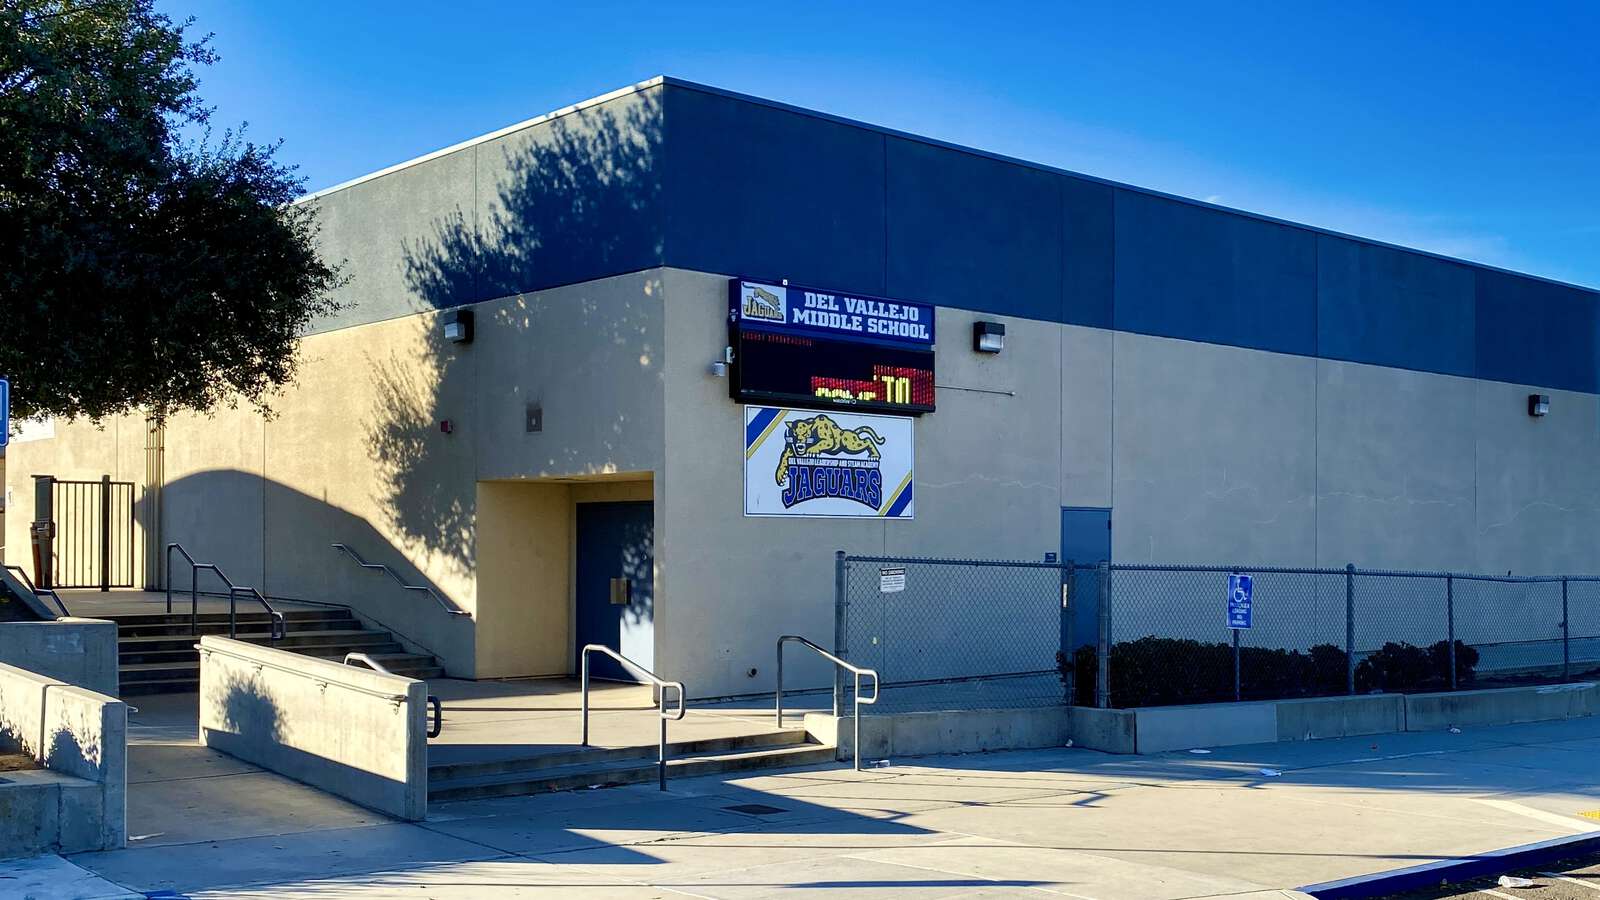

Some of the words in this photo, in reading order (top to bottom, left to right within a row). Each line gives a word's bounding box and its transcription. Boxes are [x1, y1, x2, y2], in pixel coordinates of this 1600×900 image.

[804, 292, 839, 311] DEL
[844, 297, 919, 322] VALLEJO
[792, 308, 862, 332] MIDDLE
[867, 318, 929, 340] SCHOOL
[783, 465, 881, 509] JAGUARS
